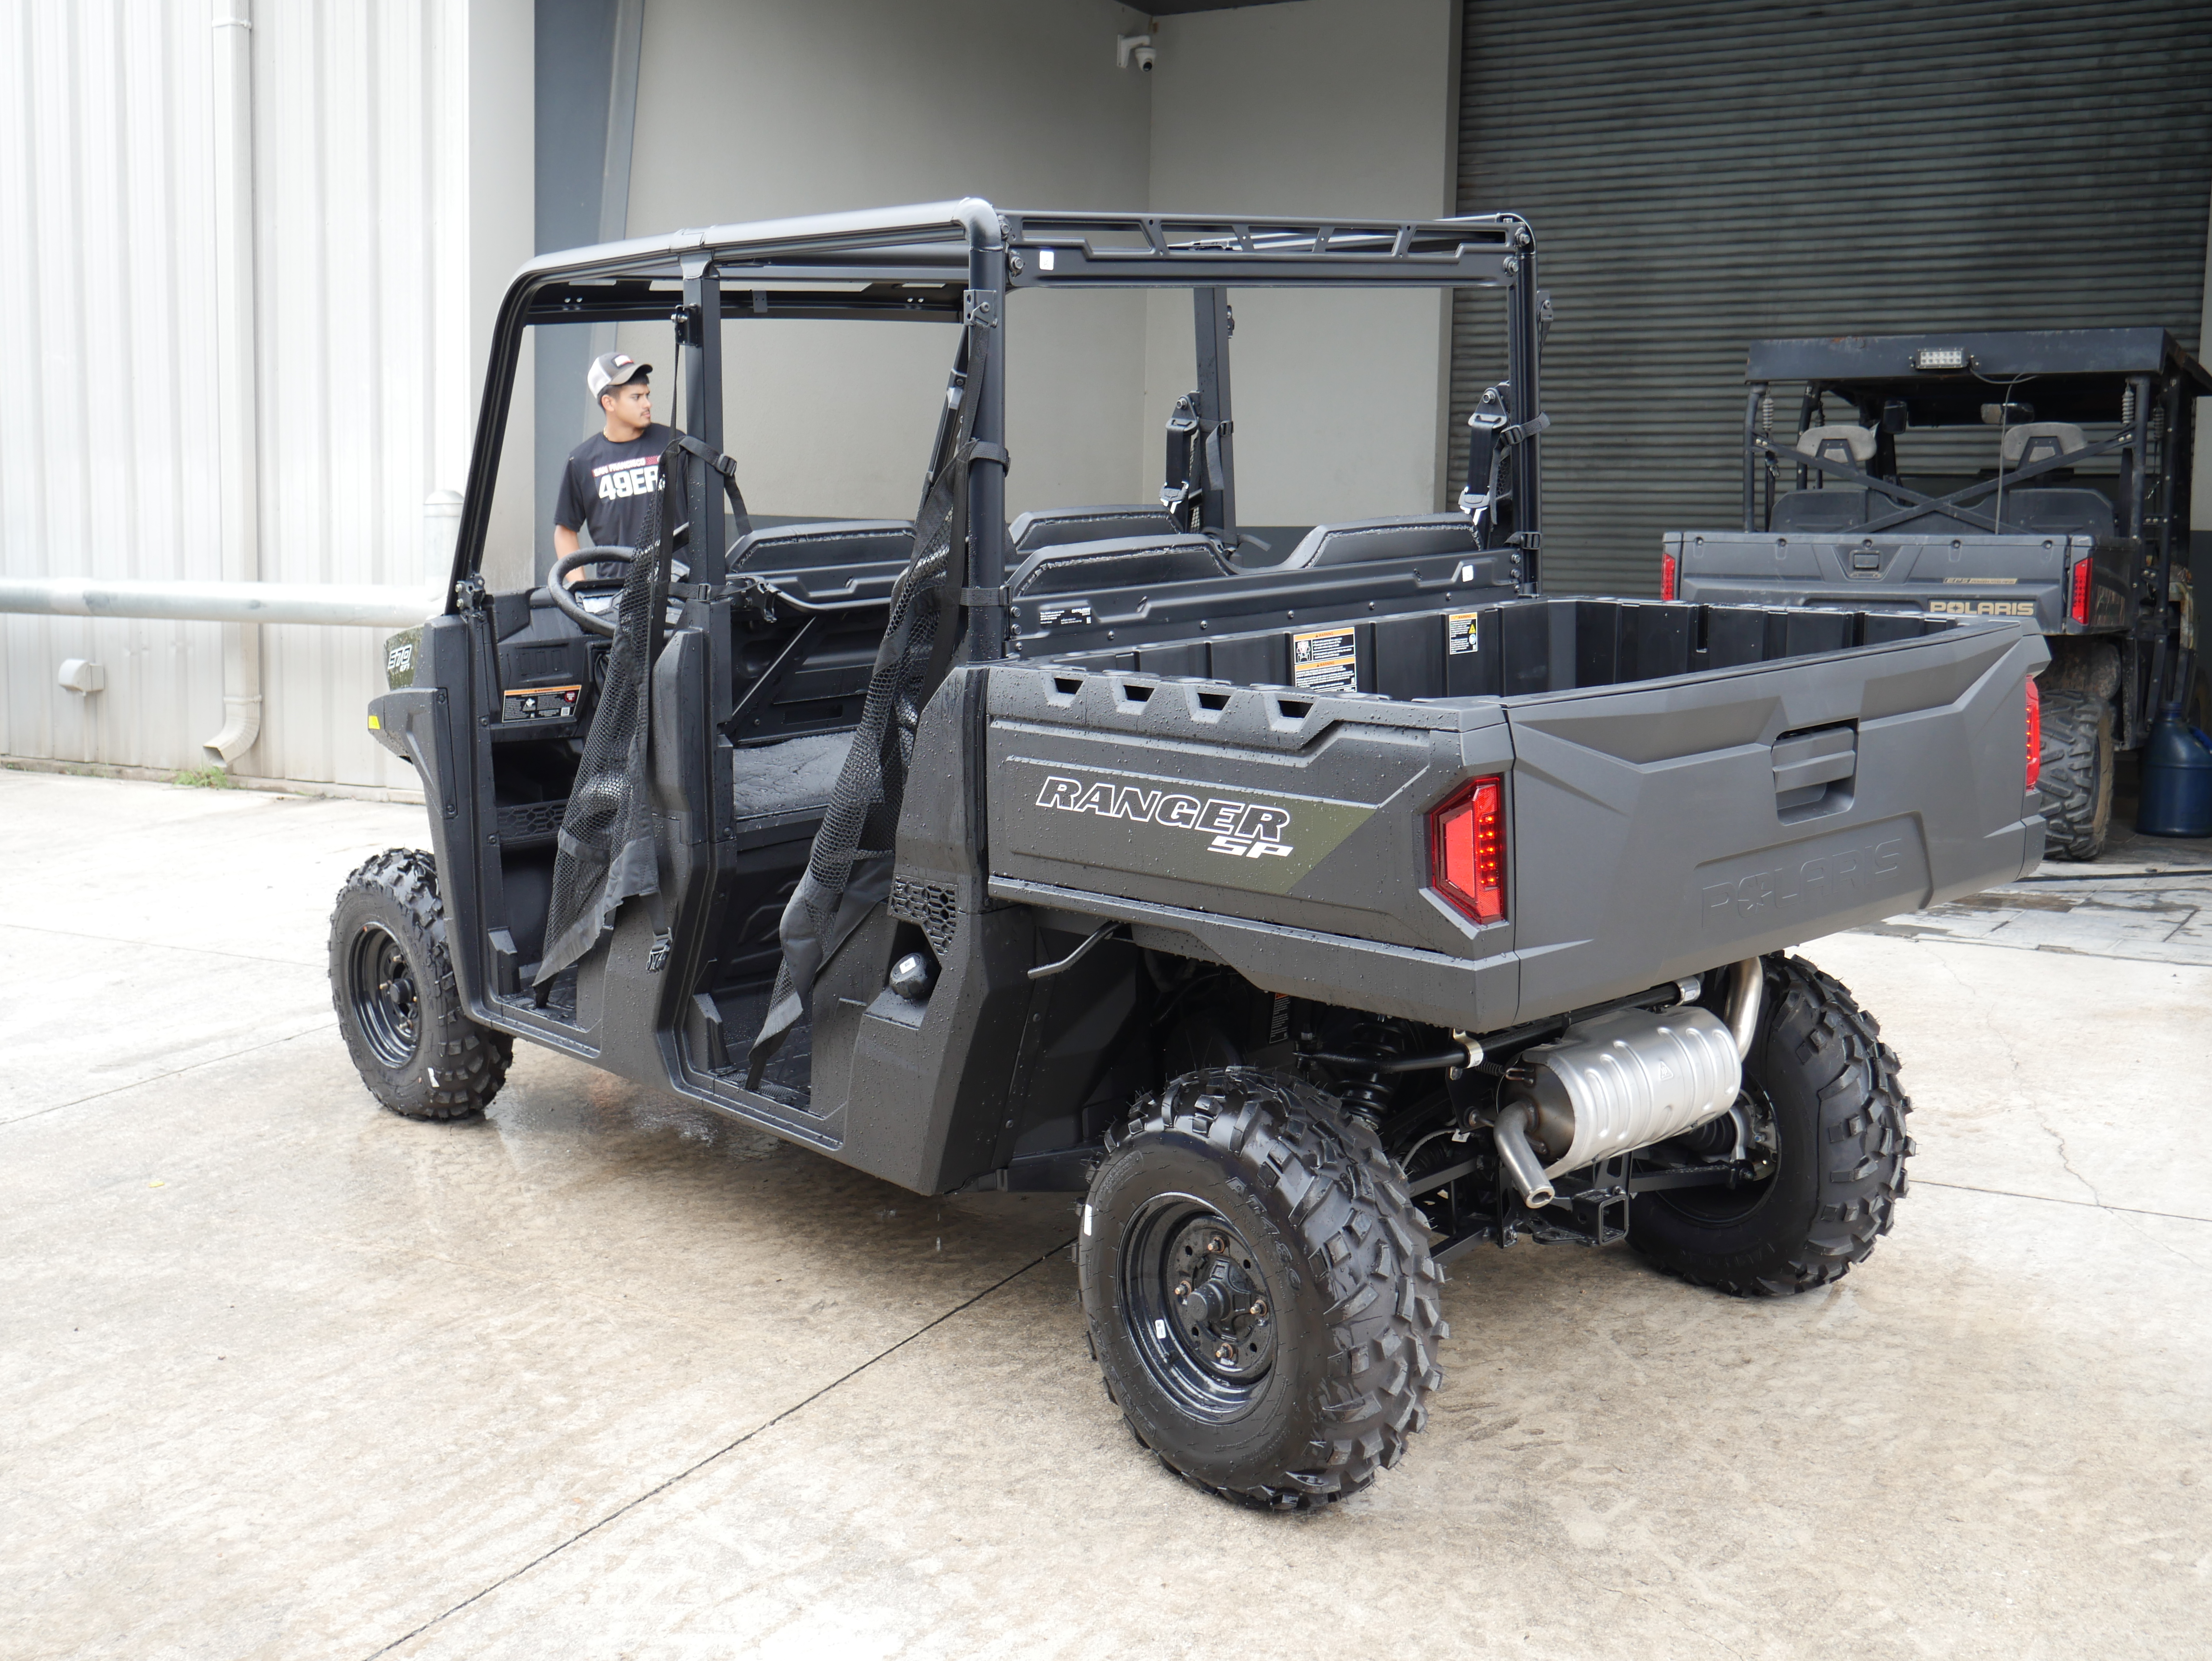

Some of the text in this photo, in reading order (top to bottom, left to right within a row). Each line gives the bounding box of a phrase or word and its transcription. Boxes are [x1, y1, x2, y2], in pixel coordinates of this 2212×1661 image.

[593, 458, 646, 477] SAN FRANCISCO
[599, 464, 659, 500] 49ER
[1930, 602, 2034, 616] POLARIS
[387, 644, 412, 670] 570
[1036, 776, 1290, 842] RANGER
[1207, 835, 1293, 858] SP
[1701, 838, 1902, 929] POLARIS
